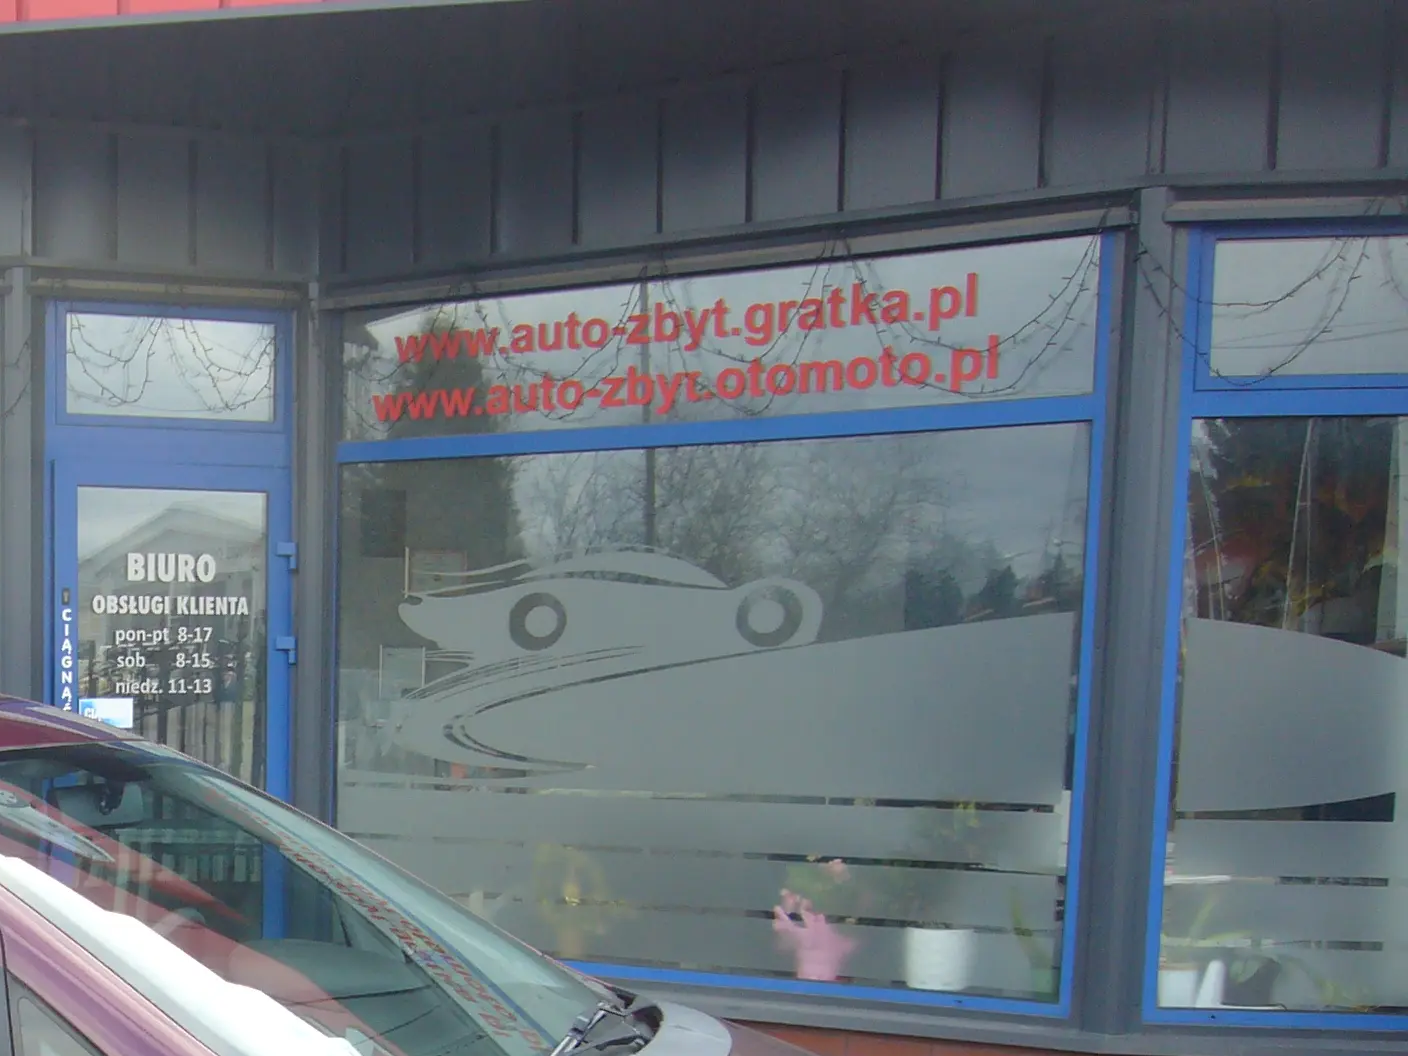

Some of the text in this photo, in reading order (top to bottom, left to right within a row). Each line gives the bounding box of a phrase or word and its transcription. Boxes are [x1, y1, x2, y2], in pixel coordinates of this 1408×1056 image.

[394, 272, 979, 363] www.auto-zbyt.gratka.pl
[371, 335, 999, 422] www.auto-zbyt.otomoto.pl
[127, 552, 217, 583] BIURO
[92, 594, 250, 616] OBSŁUGI KLIENTA
[114, 626, 214, 645] pon-pt 8-17
[116, 651, 211, 669] sob 8-15
[114, 678, 213, 695] niedz. 11-13
